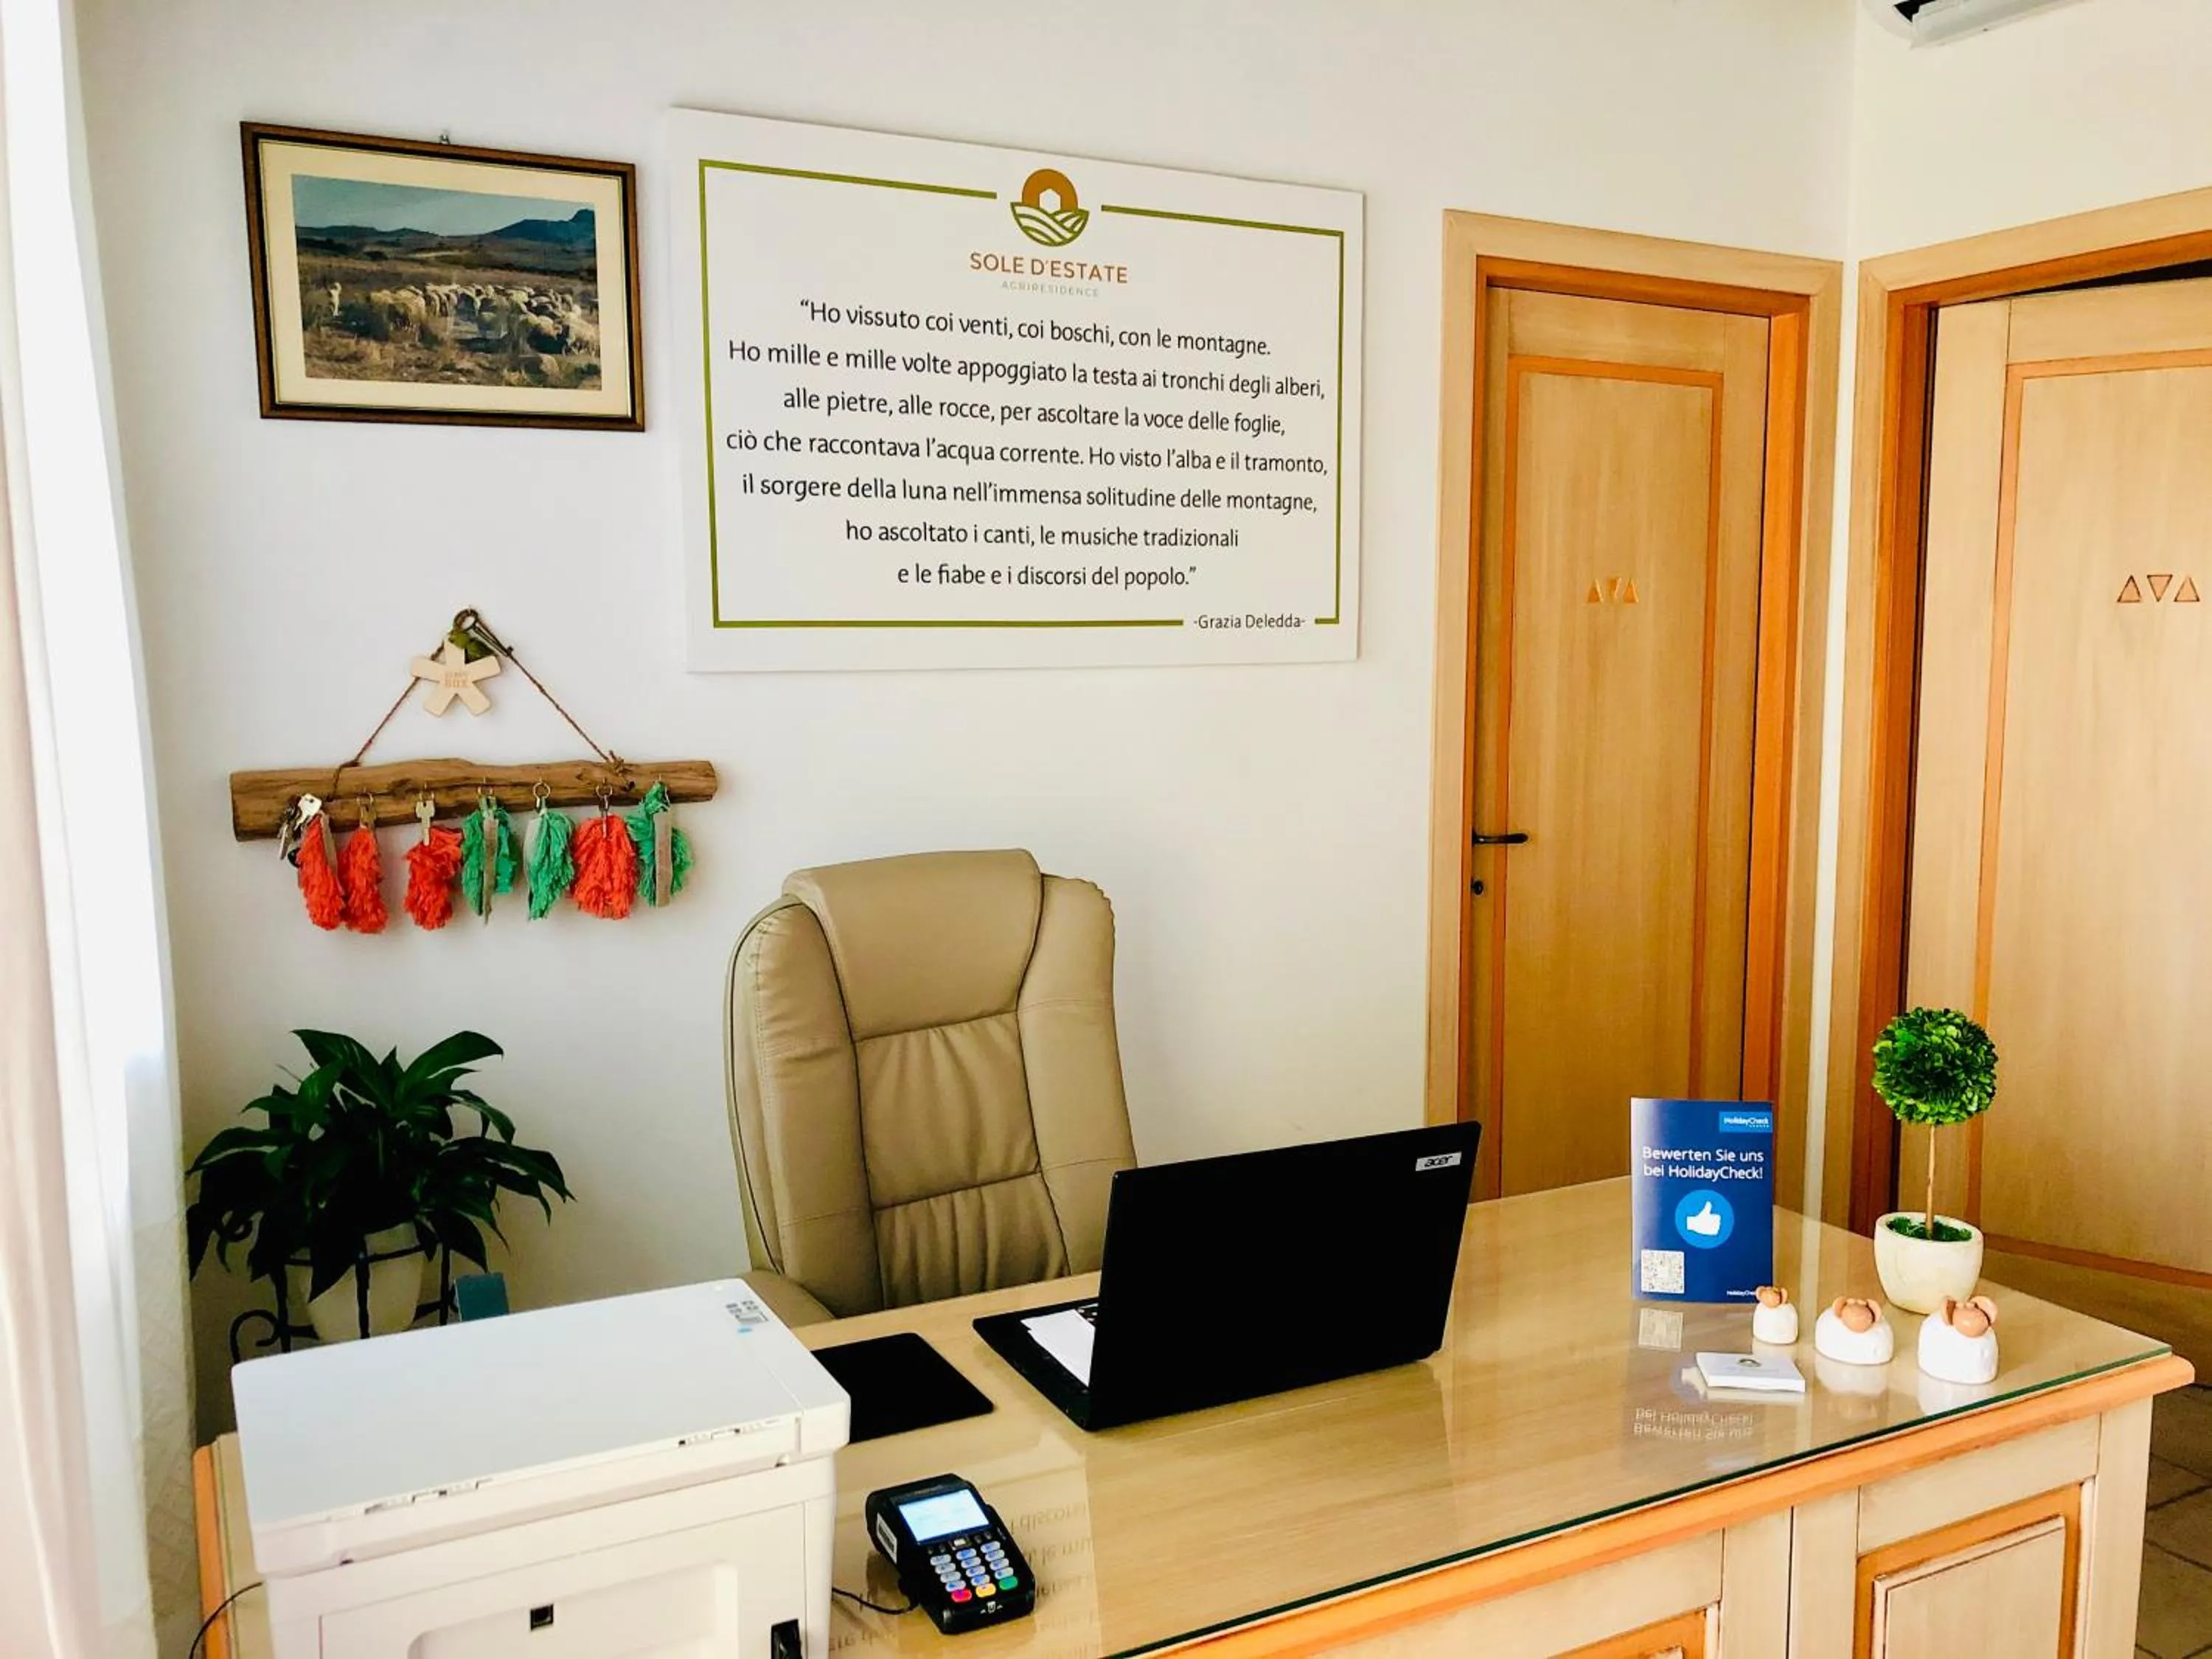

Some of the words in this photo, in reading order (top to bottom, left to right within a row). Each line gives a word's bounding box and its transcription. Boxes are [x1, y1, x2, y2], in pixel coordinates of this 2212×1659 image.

[970, 251, 1025, 274] SOLE
[1030, 258, 1127, 284] D'ESTATE
[845, 304, 920, 330] vissuto
[925, 312, 953, 332] coi
[958, 316, 1013, 340] venti,
[1017, 319, 1044, 339] coi
[1050, 319, 1115, 348] boschi,
[1118, 330, 1151, 347] con
[1156, 327, 1172, 349] le
[1177, 334, 1271, 359] montagne.
[728, 338, 761, 362] Ho
[767, 342, 821, 366] mille
[826, 351, 839, 367] e
[845, 348, 897, 372] mille
[901, 351, 952, 375] volte
[956, 360, 1068, 386] appoggiato
[1072, 362, 1088, 384] la
[1092, 366, 1138, 387] testa
[1141, 368, 1157, 388] ai
[1161, 371, 1225, 392] tronchi
[1228, 372, 1270, 400] degli
[1274, 375, 1325, 400] alberi,
[783, 386, 821, 410] alle
[826, 390, 894, 417] pietre,
[897, 393, 933, 416] alle
[938, 401, 995, 422] rocce,
[1000, 404, 1032, 426] per
[1037, 403, 1119, 426] ascoltare
[1124, 406, 1139, 427] la
[1143, 412, 1184, 429] voce
[1187, 409, 1230, 431] delle
[1234, 411, 1285, 439] foglie,
[726, 428, 758, 451] ciò
[762, 429, 802, 453] che
[808, 437, 920, 458] raccontava
[998, 445, 1084, 465] corrente.
[1088, 445, 1116, 466] Ho
[1119, 448, 1162, 468] visto
[1215, 454, 1226, 470] e
[1230, 451, 1239, 470] il
[1244, 453, 1328, 476] tramonto,
[742, 472, 754, 495] il
[759, 478, 842, 502] sorgere
[846, 476, 897, 499] della
[902, 478, 947, 501] luna
[1085, 486, 1176, 508] solitudine
[1180, 487, 1222, 509] delle
[1226, 493, 1317, 516] montagne,
[845, 518, 873, 540] ho
[877, 521, 968, 543] ascoltato
[973, 524, 978, 543] i
[983, 525, 1035, 548] canti,
[1040, 524, 1056, 545] le
[1060, 525, 1138, 546] musiche
[1142, 526, 1239, 548] tradizionali
[897, 568, 909, 583] e
[914, 562, 932, 584] le
[936, 563, 986, 585] fiabe
[990, 569, 1002, 585] e
[1007, 565, 1012, 585] i
[1016, 564, 1086, 585] discorsi
[1091, 565, 1119, 585] del
[1193, 614, 1242, 629] -Grazia
[1245, 613, 1305, 629] Deledda-
[1425, 1155, 1453, 1167] acer
[1642, 1146, 1711, 1161] Bewerten
[1716, 1149, 1736, 1162] Sie
[1739, 1151, 1764, 1163] uns
[1644, 1164, 1664, 1177] bei
[1669, 1165, 1763, 1182] HolidayCheck!
